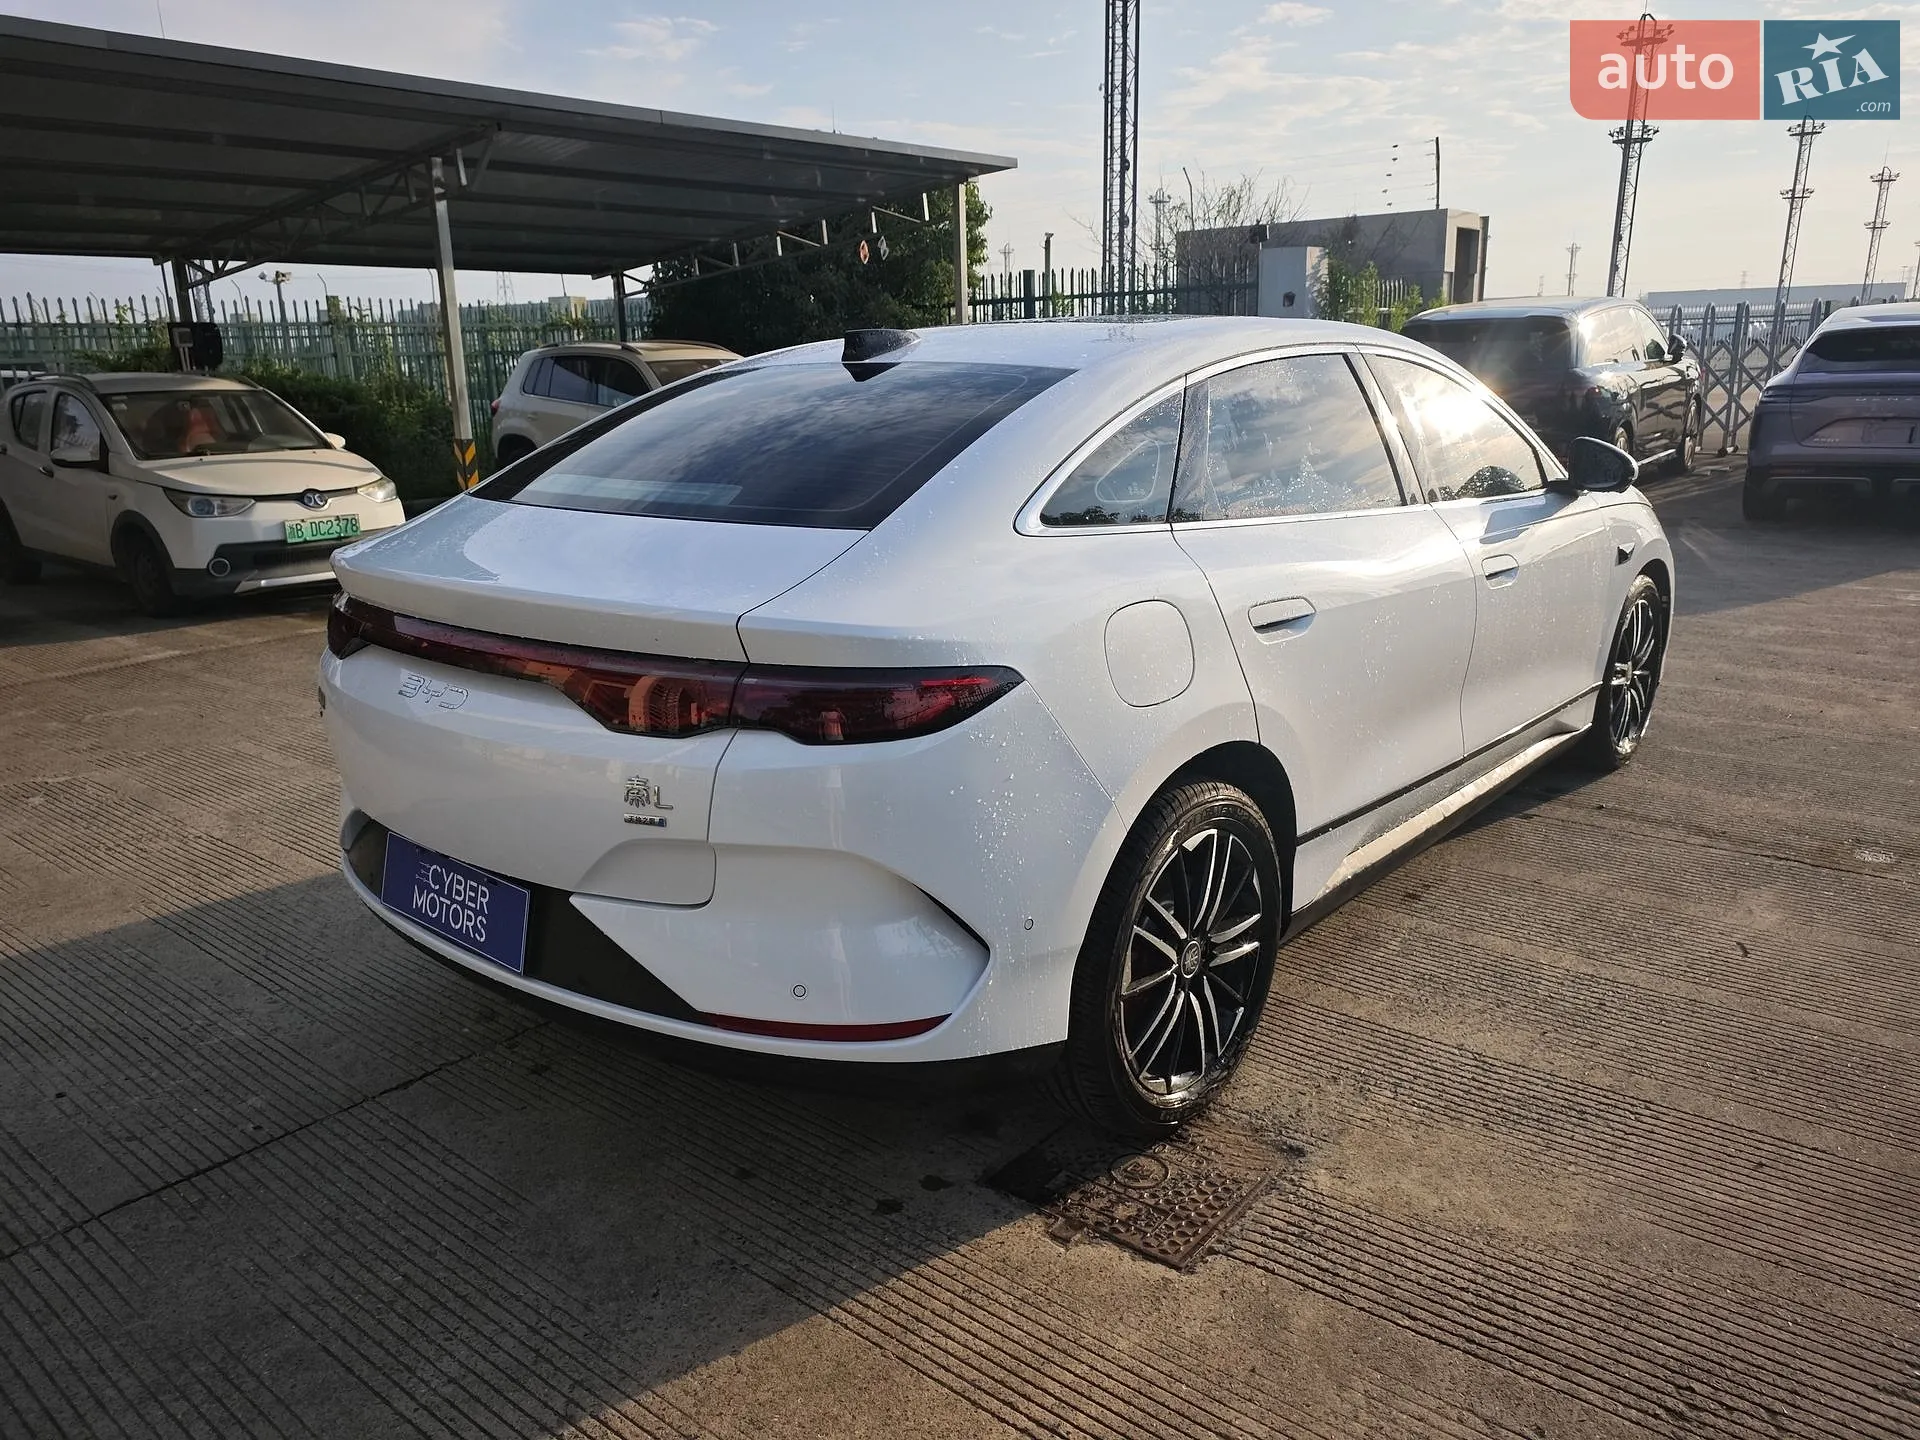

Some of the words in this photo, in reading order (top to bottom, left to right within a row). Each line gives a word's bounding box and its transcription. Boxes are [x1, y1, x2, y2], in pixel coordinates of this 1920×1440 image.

[310, 517, 359, 537] DC2378
[399, 673, 469, 710] BYD
[428, 864, 490, 914] CYBER
[412, 885, 487, 943] MOTORS
